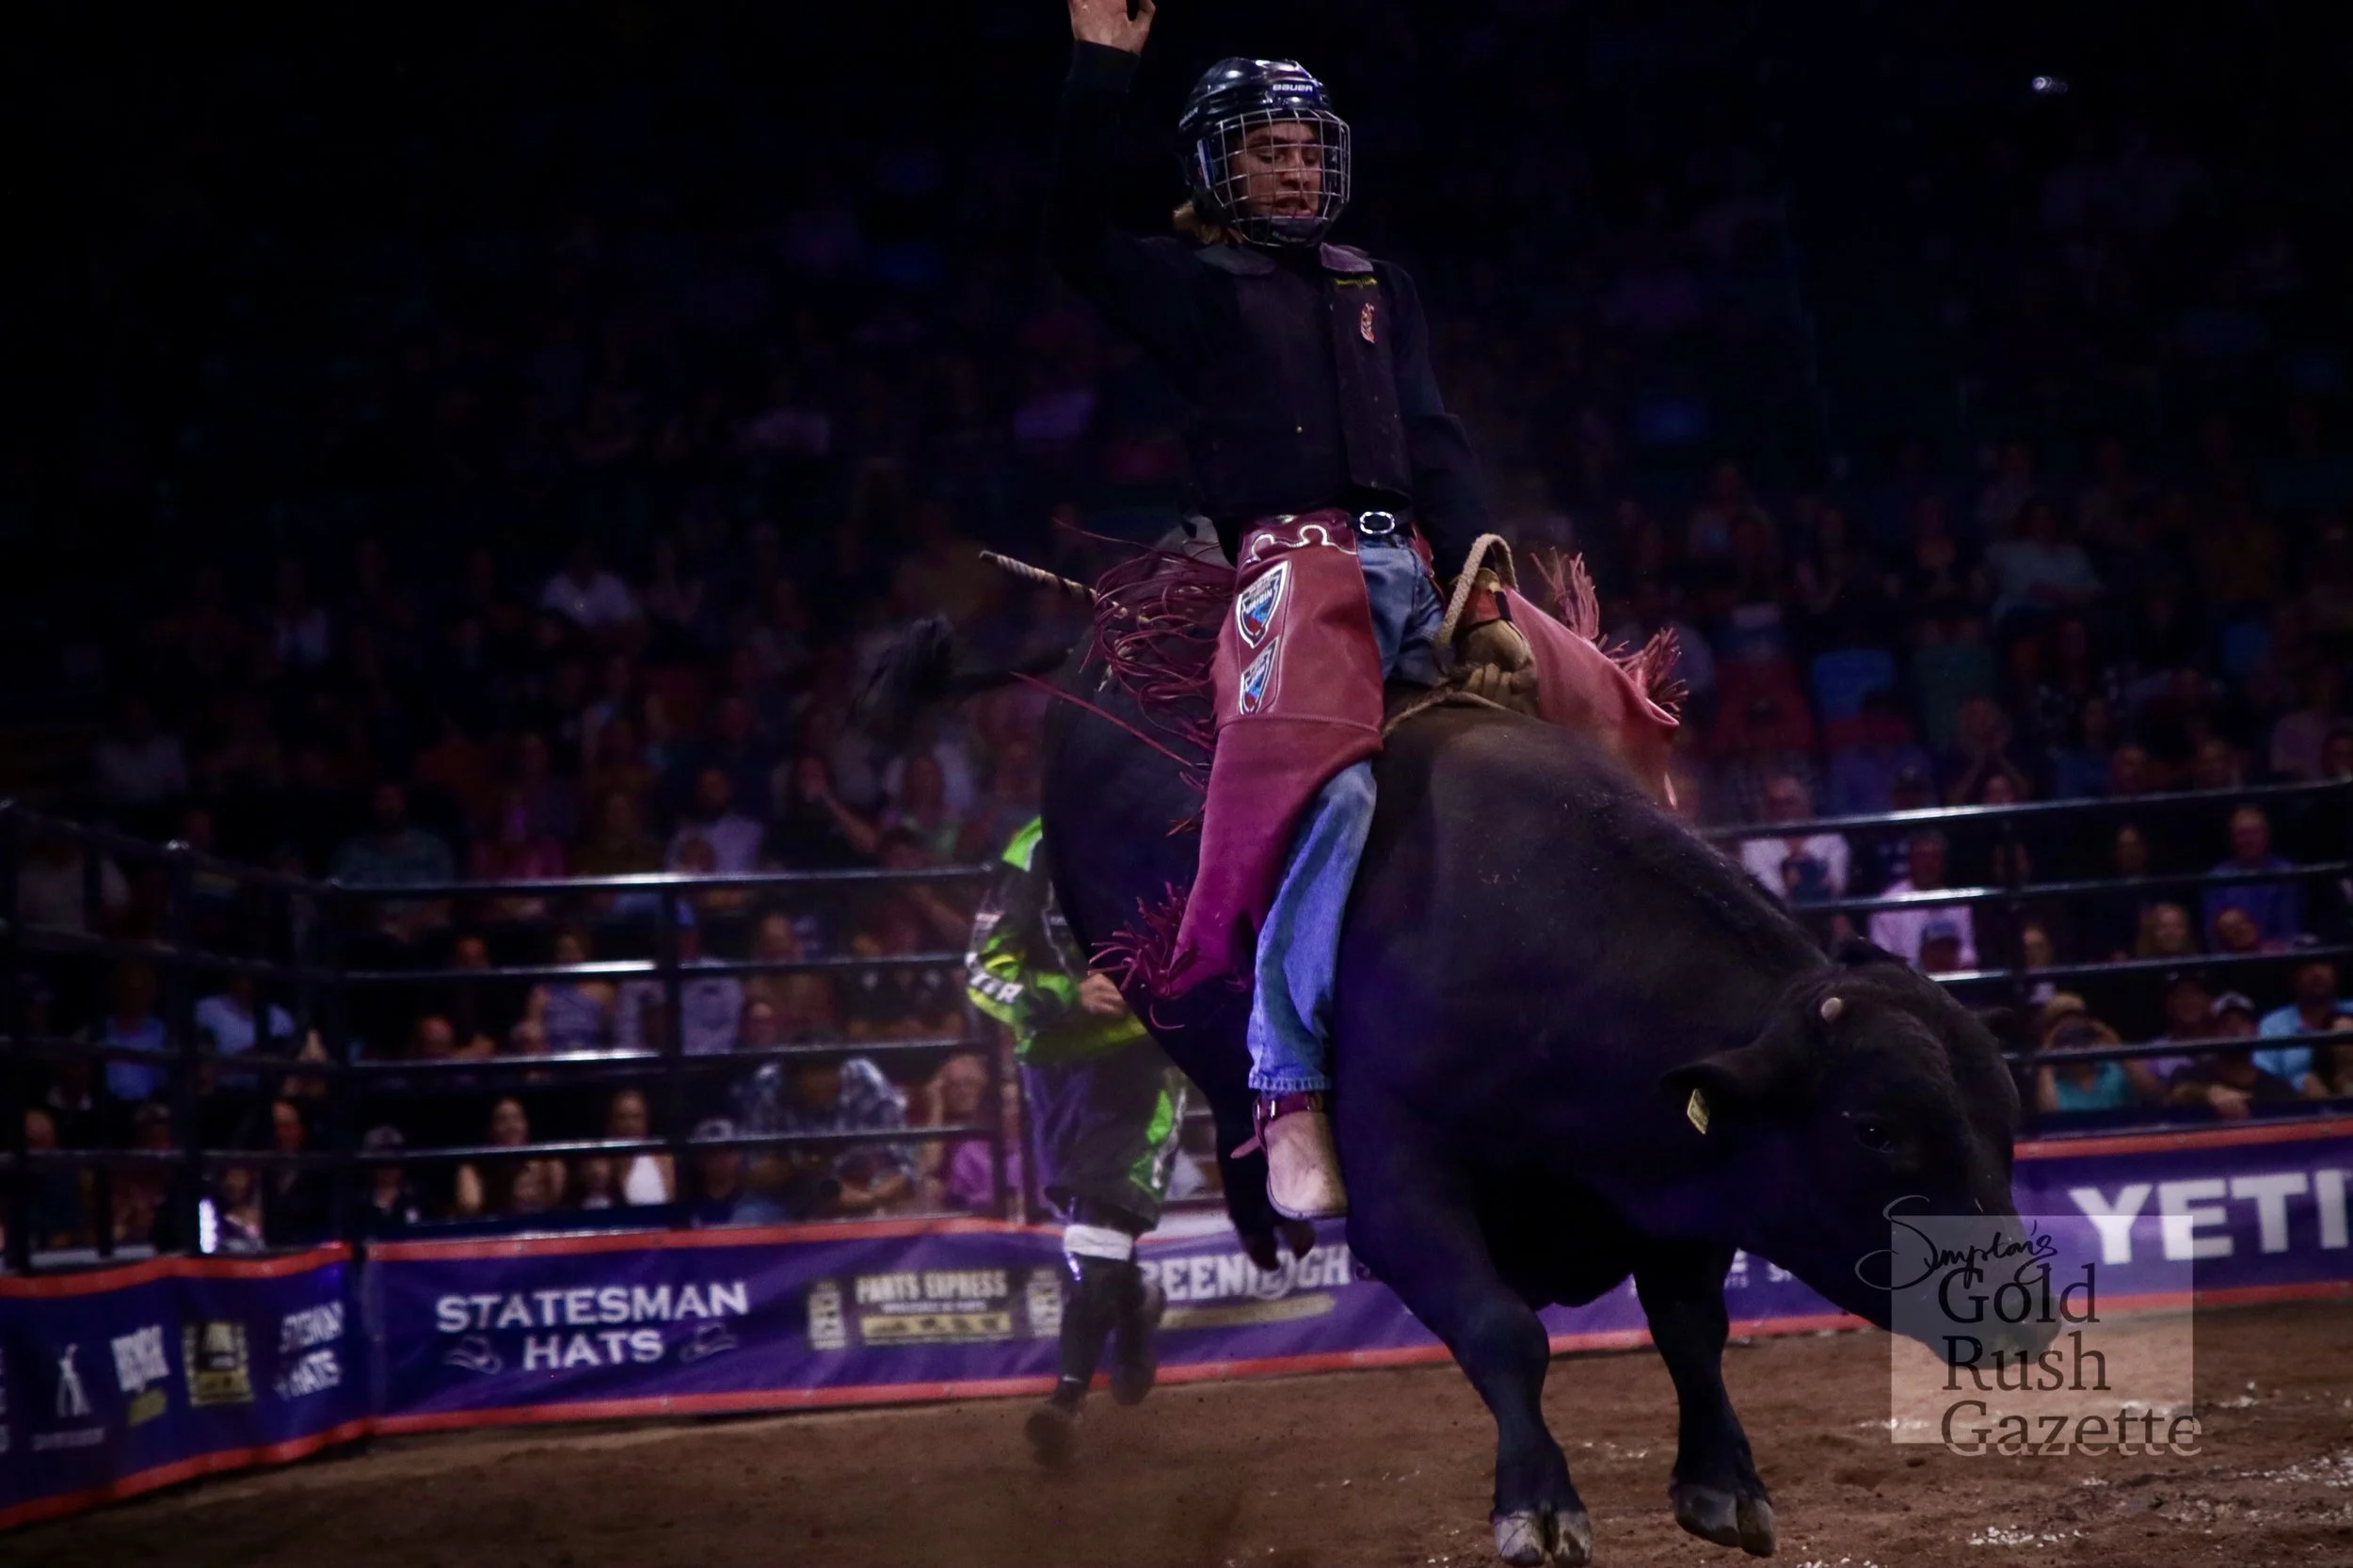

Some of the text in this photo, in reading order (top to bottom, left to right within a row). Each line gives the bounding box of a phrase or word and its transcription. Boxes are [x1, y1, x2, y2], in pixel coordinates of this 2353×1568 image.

[1273, 83, 1314, 92] BAUER
[2069, 1168, 2351, 1265] YETI
[435, 1280, 751, 1335] STATESMAN
[521, 1327, 666, 1371] HATS
